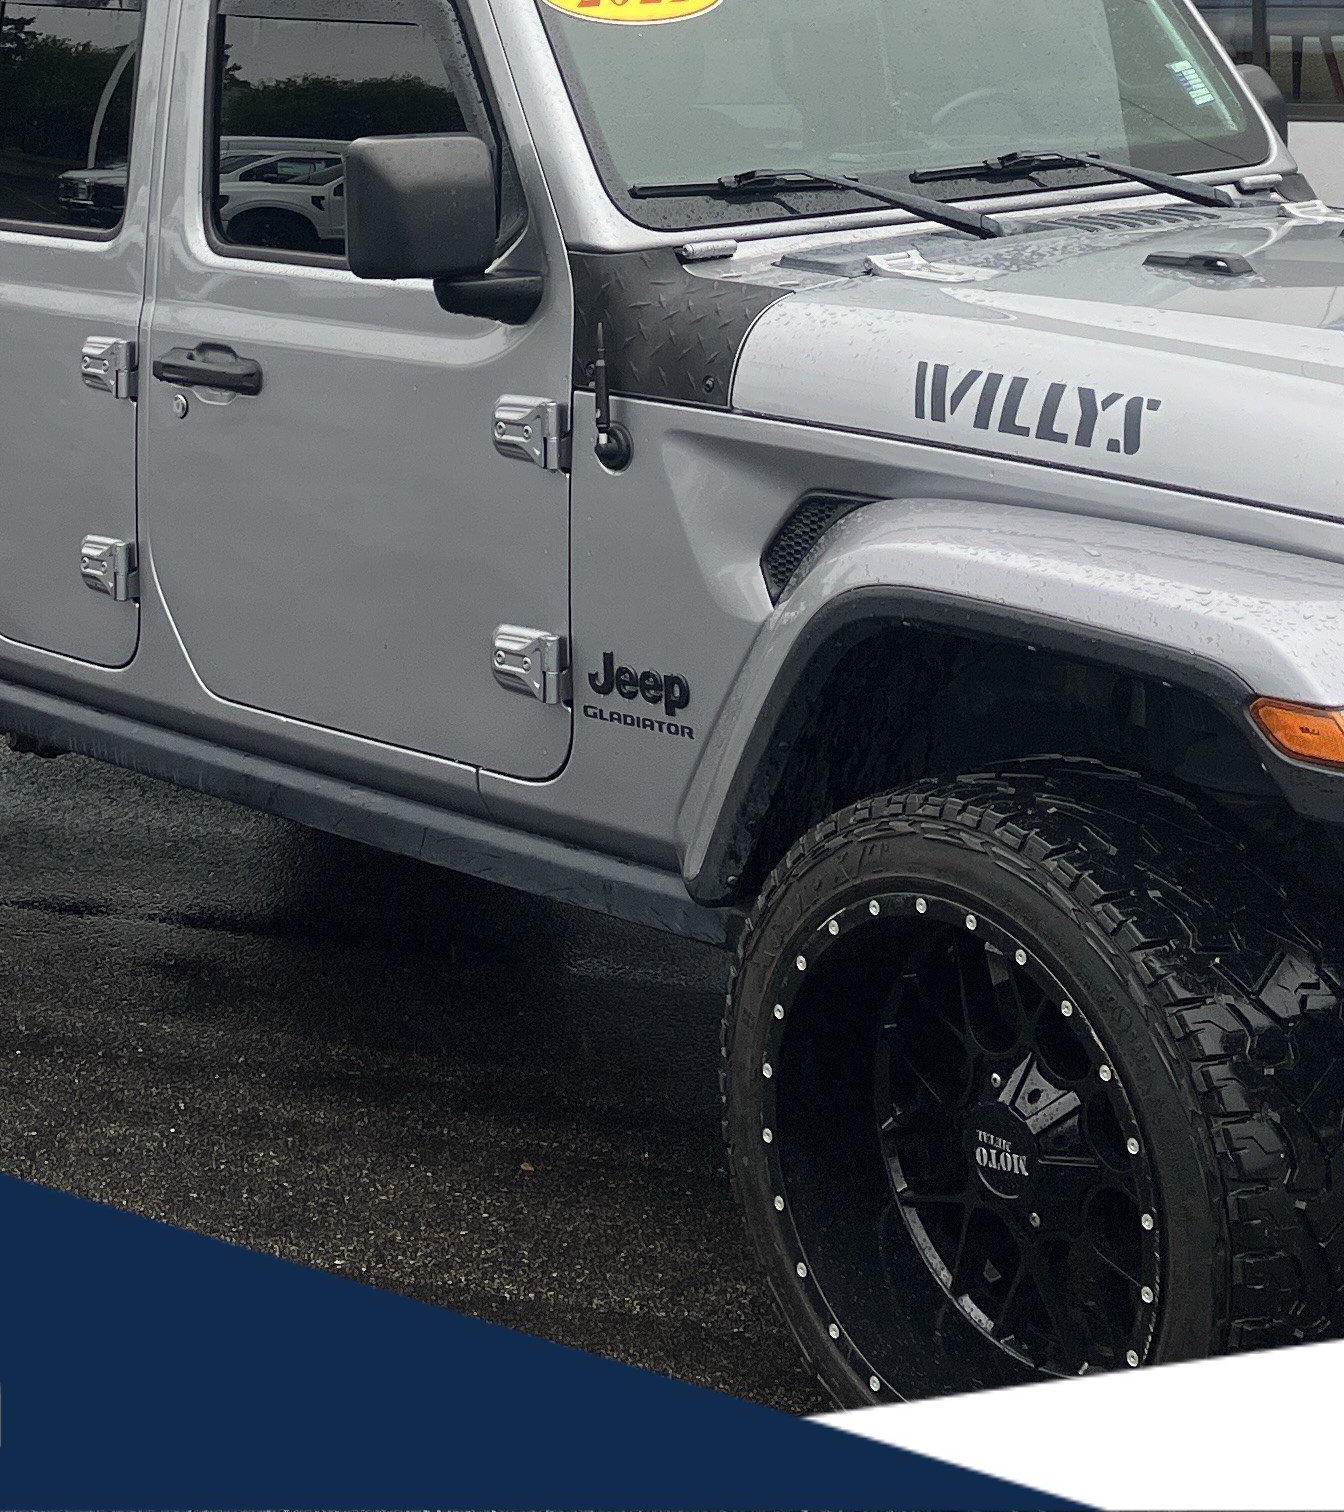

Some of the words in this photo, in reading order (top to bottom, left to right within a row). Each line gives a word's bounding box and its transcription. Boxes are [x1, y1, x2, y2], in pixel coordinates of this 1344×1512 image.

[913, 360, 1163, 457] WILLYS
[587, 650, 691, 717] Jeep
[582, 704, 695, 740] GLADIATOR
[975, 1146, 1029, 1176] MOTO
